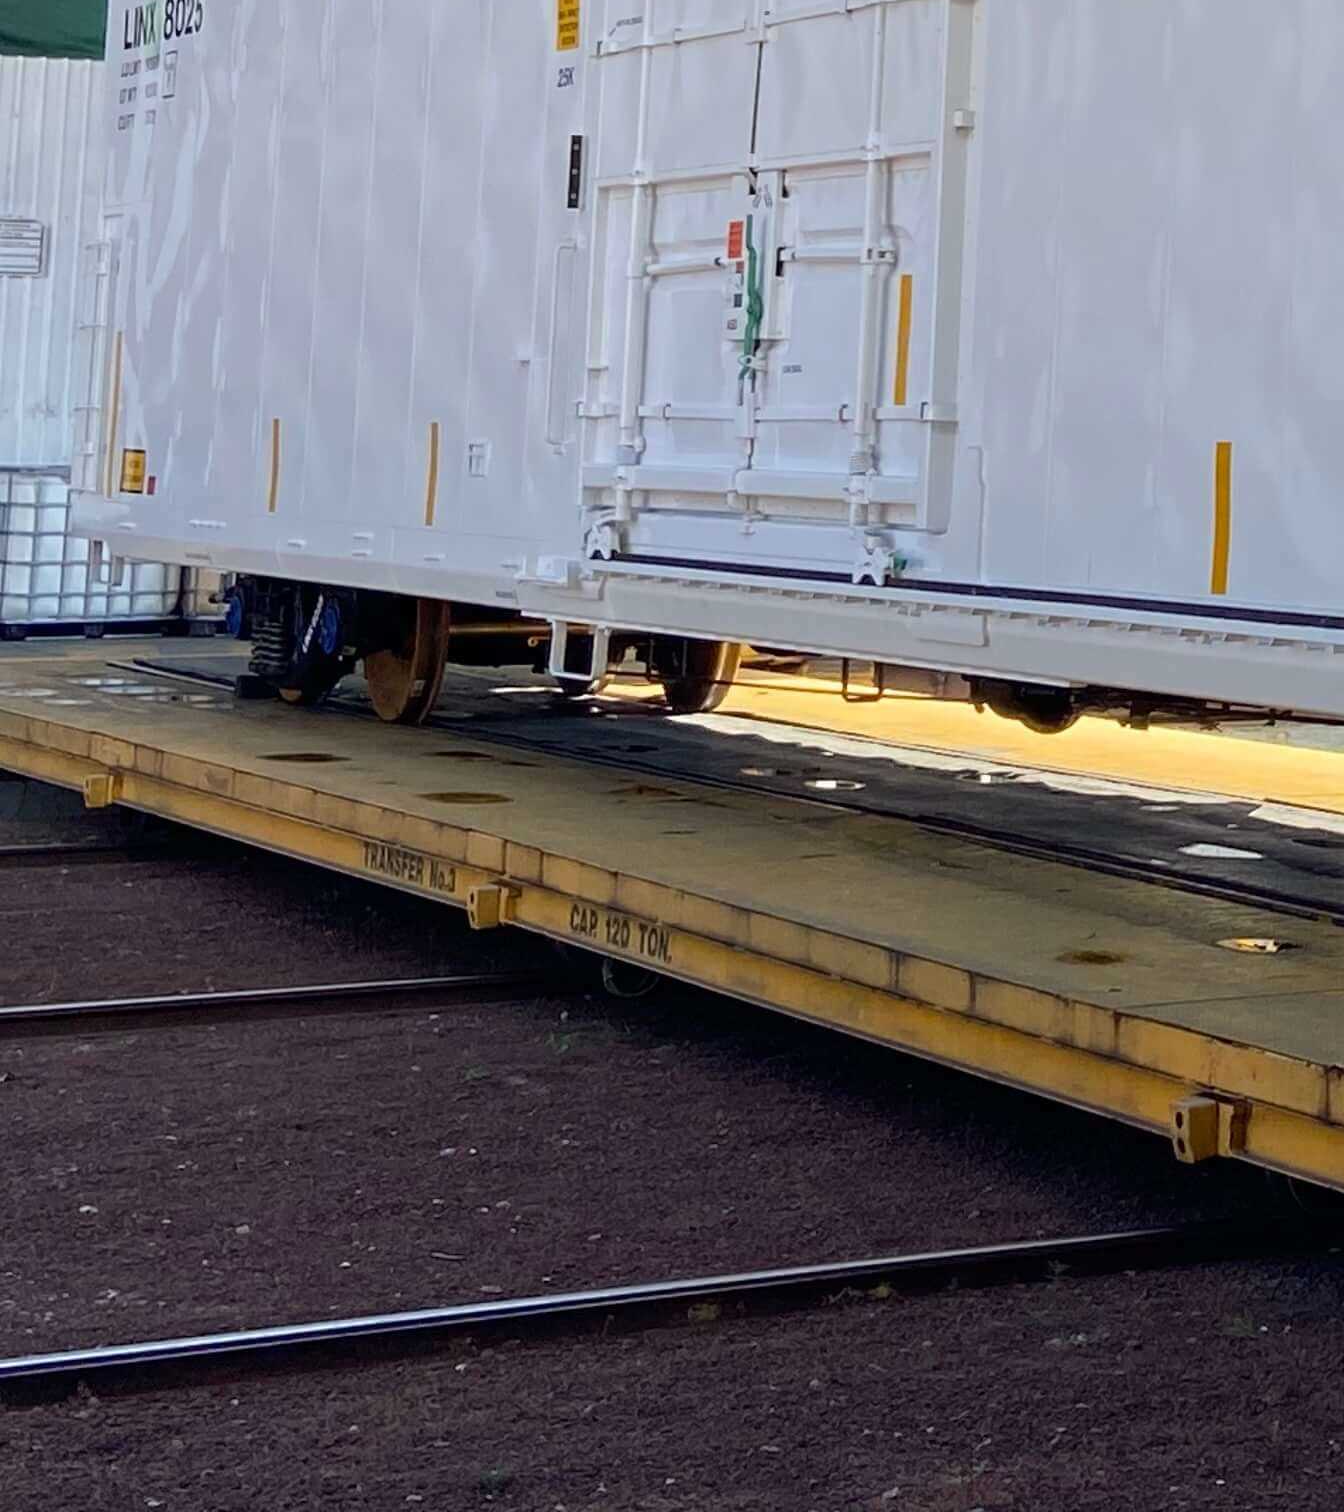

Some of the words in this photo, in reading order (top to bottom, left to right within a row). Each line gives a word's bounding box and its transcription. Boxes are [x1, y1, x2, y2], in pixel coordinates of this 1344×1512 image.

[123, 0, 157, 50] LINX
[362, 841, 424, 885] TRANSFER
[604, 919, 630, 949] 120
